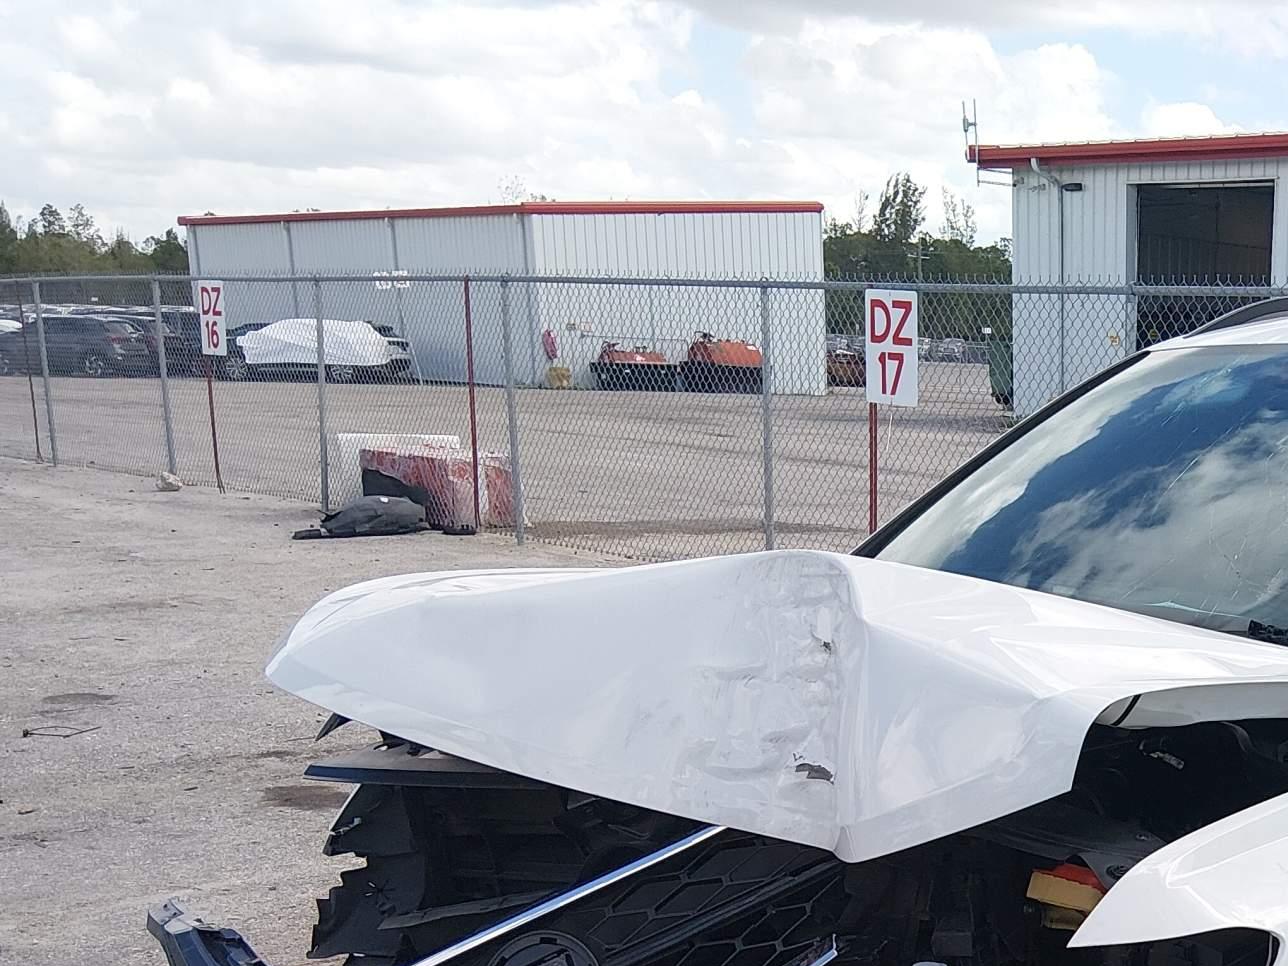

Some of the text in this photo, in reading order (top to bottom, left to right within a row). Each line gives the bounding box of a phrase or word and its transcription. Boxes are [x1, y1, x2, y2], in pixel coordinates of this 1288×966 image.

[201, 286, 222, 316] DZ
[205, 320, 219, 349] 16
[870, 298, 912, 346] DZ
[878, 351, 904, 396] 17
